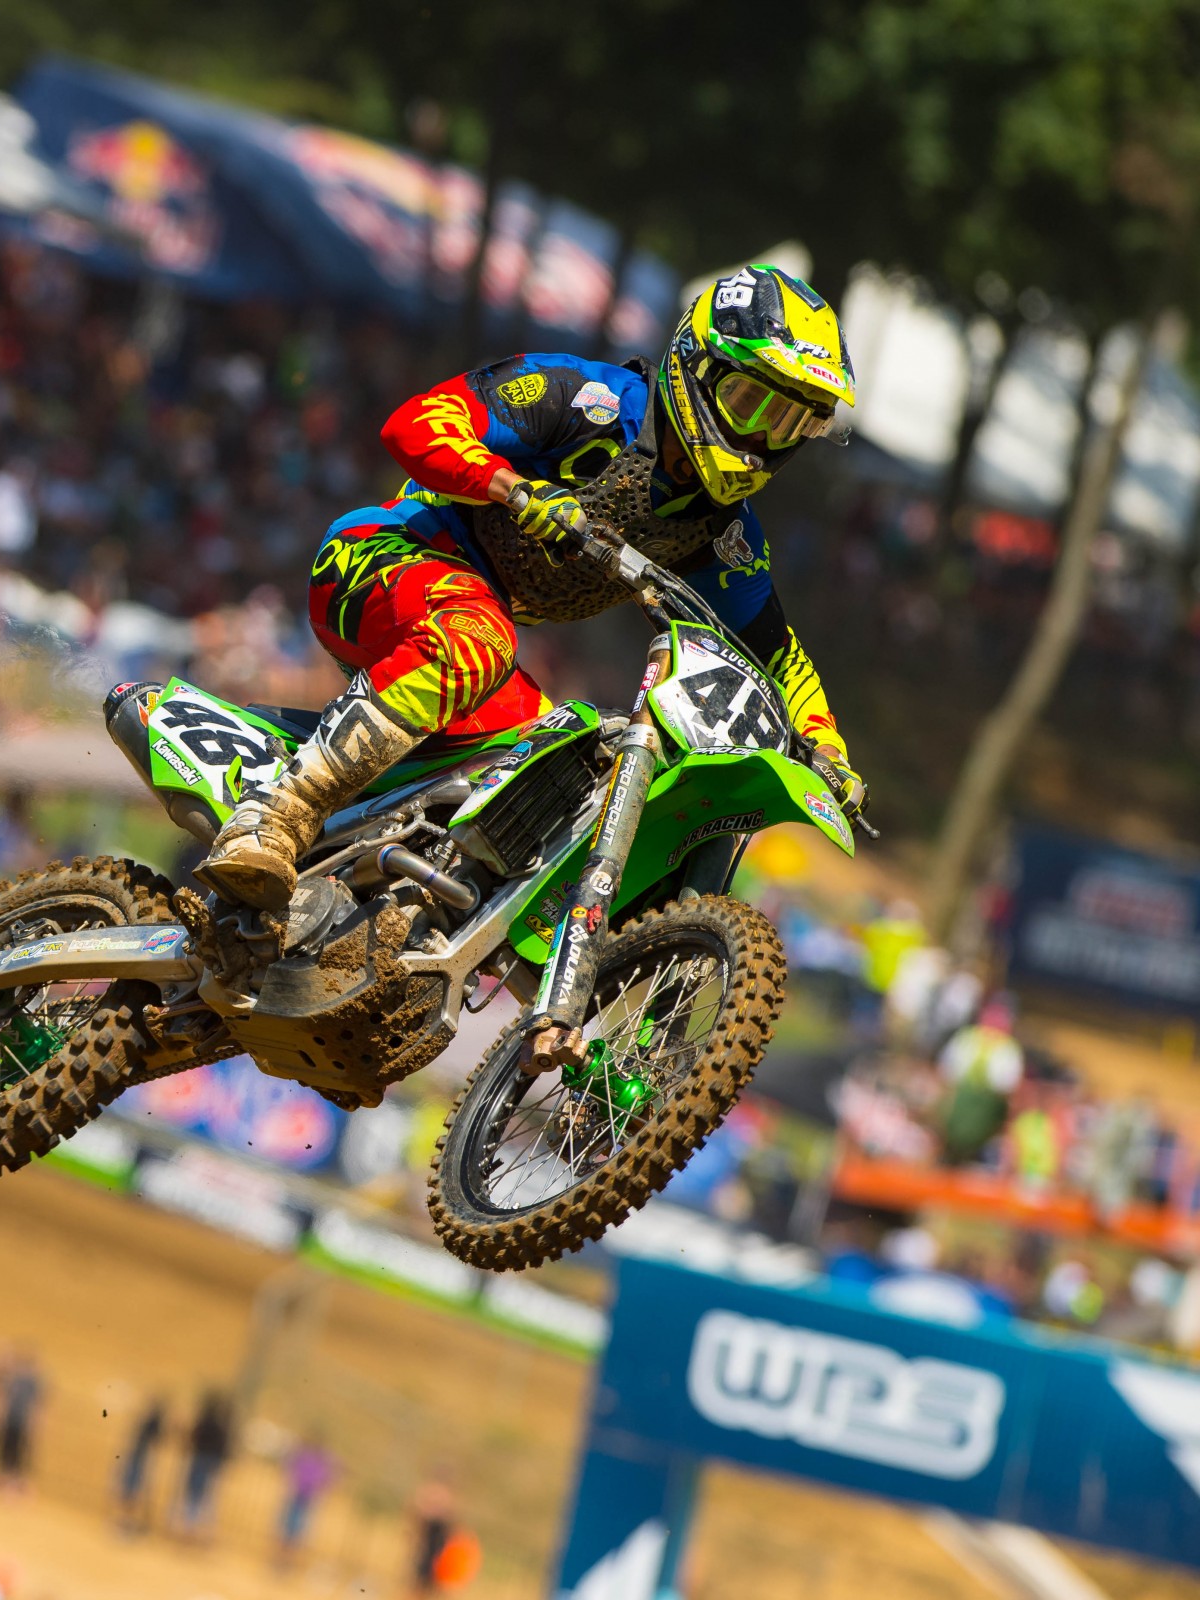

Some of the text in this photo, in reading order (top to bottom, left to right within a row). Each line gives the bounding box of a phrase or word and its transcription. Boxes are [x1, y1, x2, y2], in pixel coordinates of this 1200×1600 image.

[715, 268, 757, 310] 48
[812, 367, 844, 386] BELL
[720, 649, 759, 680] LUCAS
[759, 680, 773, 700] OIL
[160, 700, 276, 769] 48
[151, 737, 203, 786] Kawasaki
[619, 752, 638, 787] PRO
[813, 761, 842, 788] ARC
[602, 785, 628, 847] CIRCUIT
[699, 810, 764, 839] RACING
[703, 1326, 992, 1465] WPS
